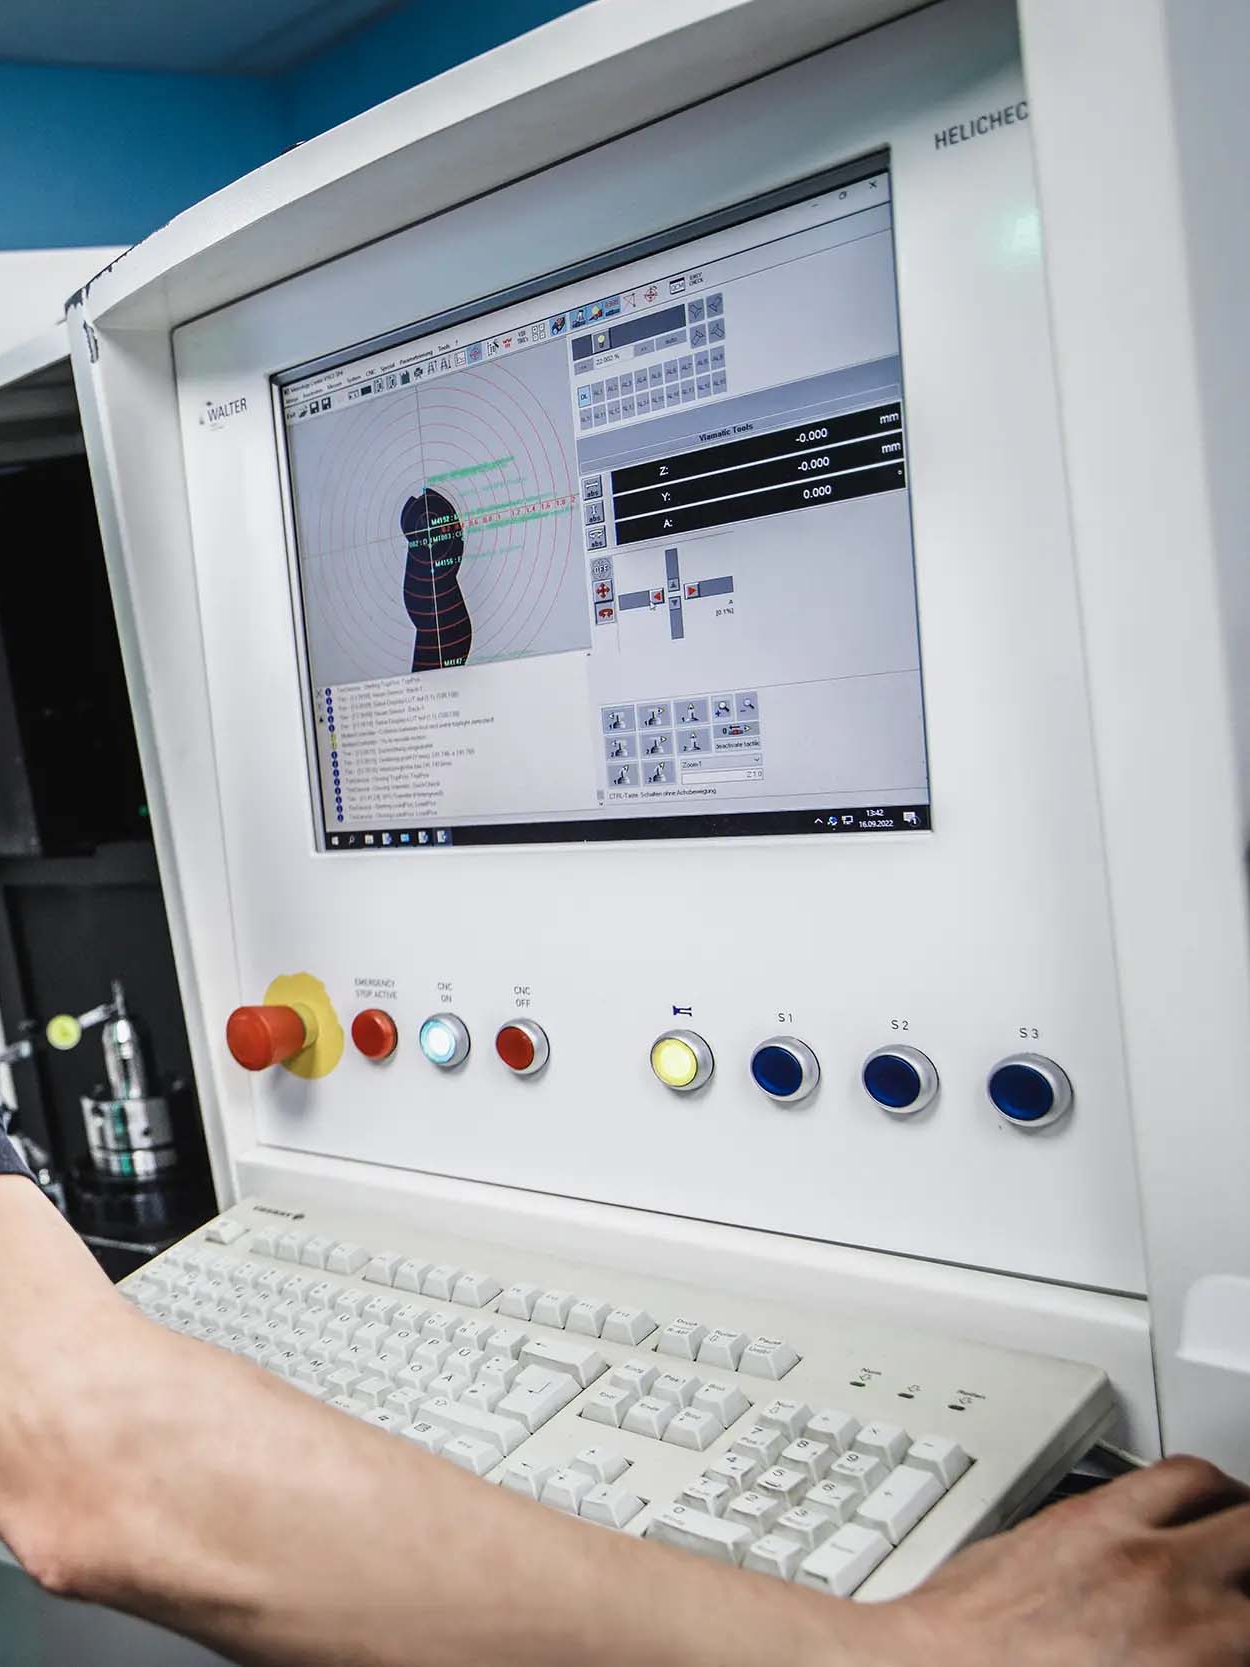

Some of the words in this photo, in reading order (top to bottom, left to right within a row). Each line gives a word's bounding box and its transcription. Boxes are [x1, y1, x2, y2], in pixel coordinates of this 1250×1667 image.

[934, 101, 1029, 150] HELICHEC
[207, 397, 248, 422] WALTER
[732, 423, 753, 436] Tools
[659, 465, 669, 477] Z:
[795, 427, 828, 444] -0.000
[879, 412, 900, 425] mm
[661, 492, 671, 502] Y:
[797, 456, 830, 471] -0.000
[881, 442, 902, 455] mm
[587, 489, 599, 497] abs
[663, 518, 673, 528] A:
[803, 485, 832, 500] 0.000
[588, 514, 601, 523] abs
[591, 539, 603, 547] abs
[866, 809, 884, 817] 13:42
[859, 819, 894, 828] 16.09.2022
[355, 978, 395, 988] EMERGENCY
[438, 982, 452, 991] CNC
[374, 990, 397, 1000] ACTIVE
[514, 986, 531, 996] CNC
[441, 994, 452, 1003] ON
[515, 998, 531, 1008] OFF
